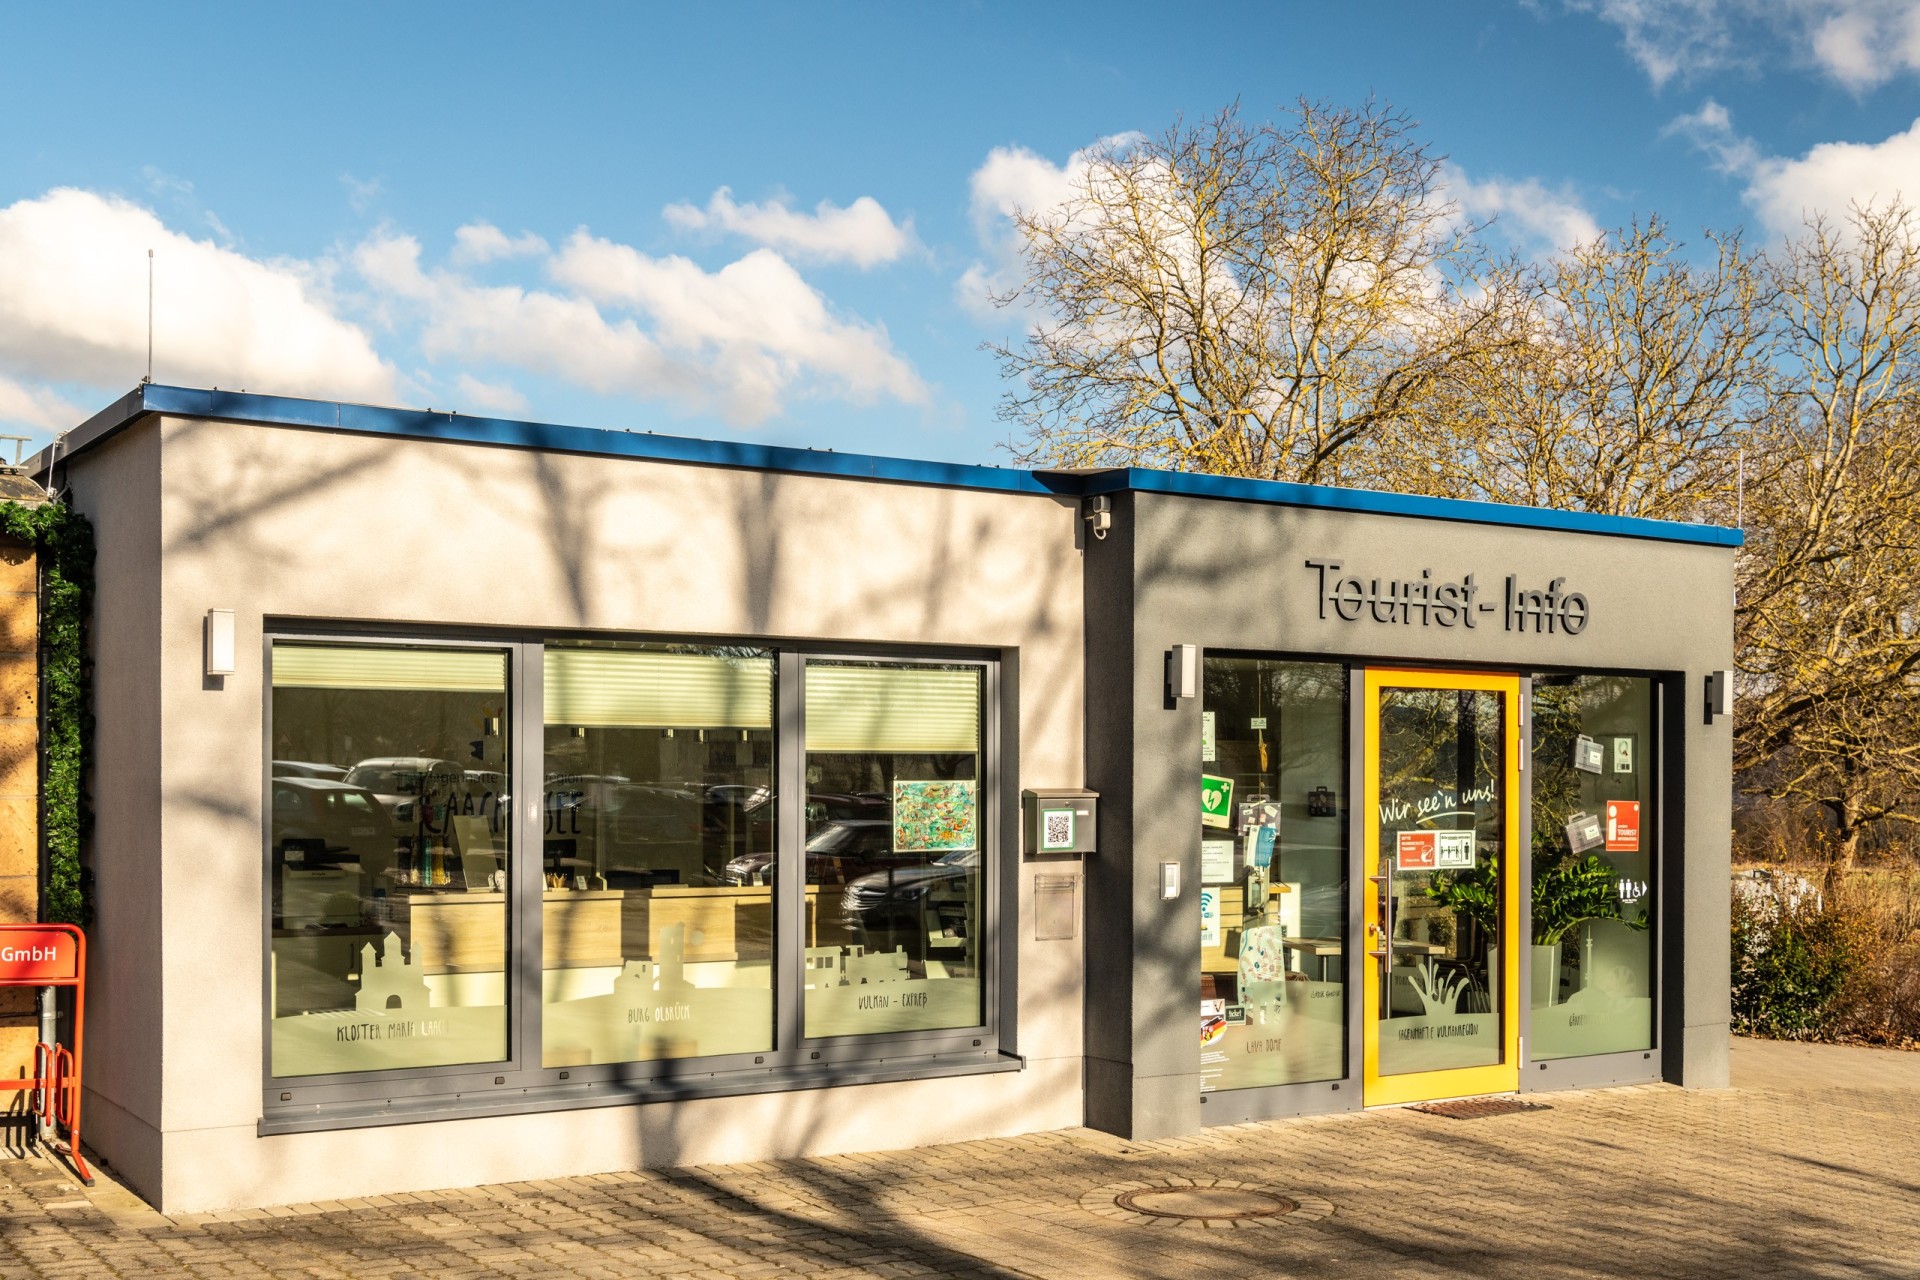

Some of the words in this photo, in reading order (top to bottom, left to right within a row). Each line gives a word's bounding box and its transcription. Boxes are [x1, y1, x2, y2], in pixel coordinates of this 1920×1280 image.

[1305, 557, 1589, 635] Tourist-Info
[1379, 798, 1411, 824] Wir
[1462, 779, 1494, 804] uns!
[1, 946, 57, 962] GmbH
[628, 1007, 650, 1023] BURG
[655, 1001, 690, 1022] OLBRÜCK
[858, 994, 889, 1010] VULKAN
[337, 1023, 381, 1042] KLOSTER
[388, 1020, 416, 1039] MARIA
[1247, 1041, 1262, 1054] LAVA
[1266, 1038, 1281, 1052] DOME
